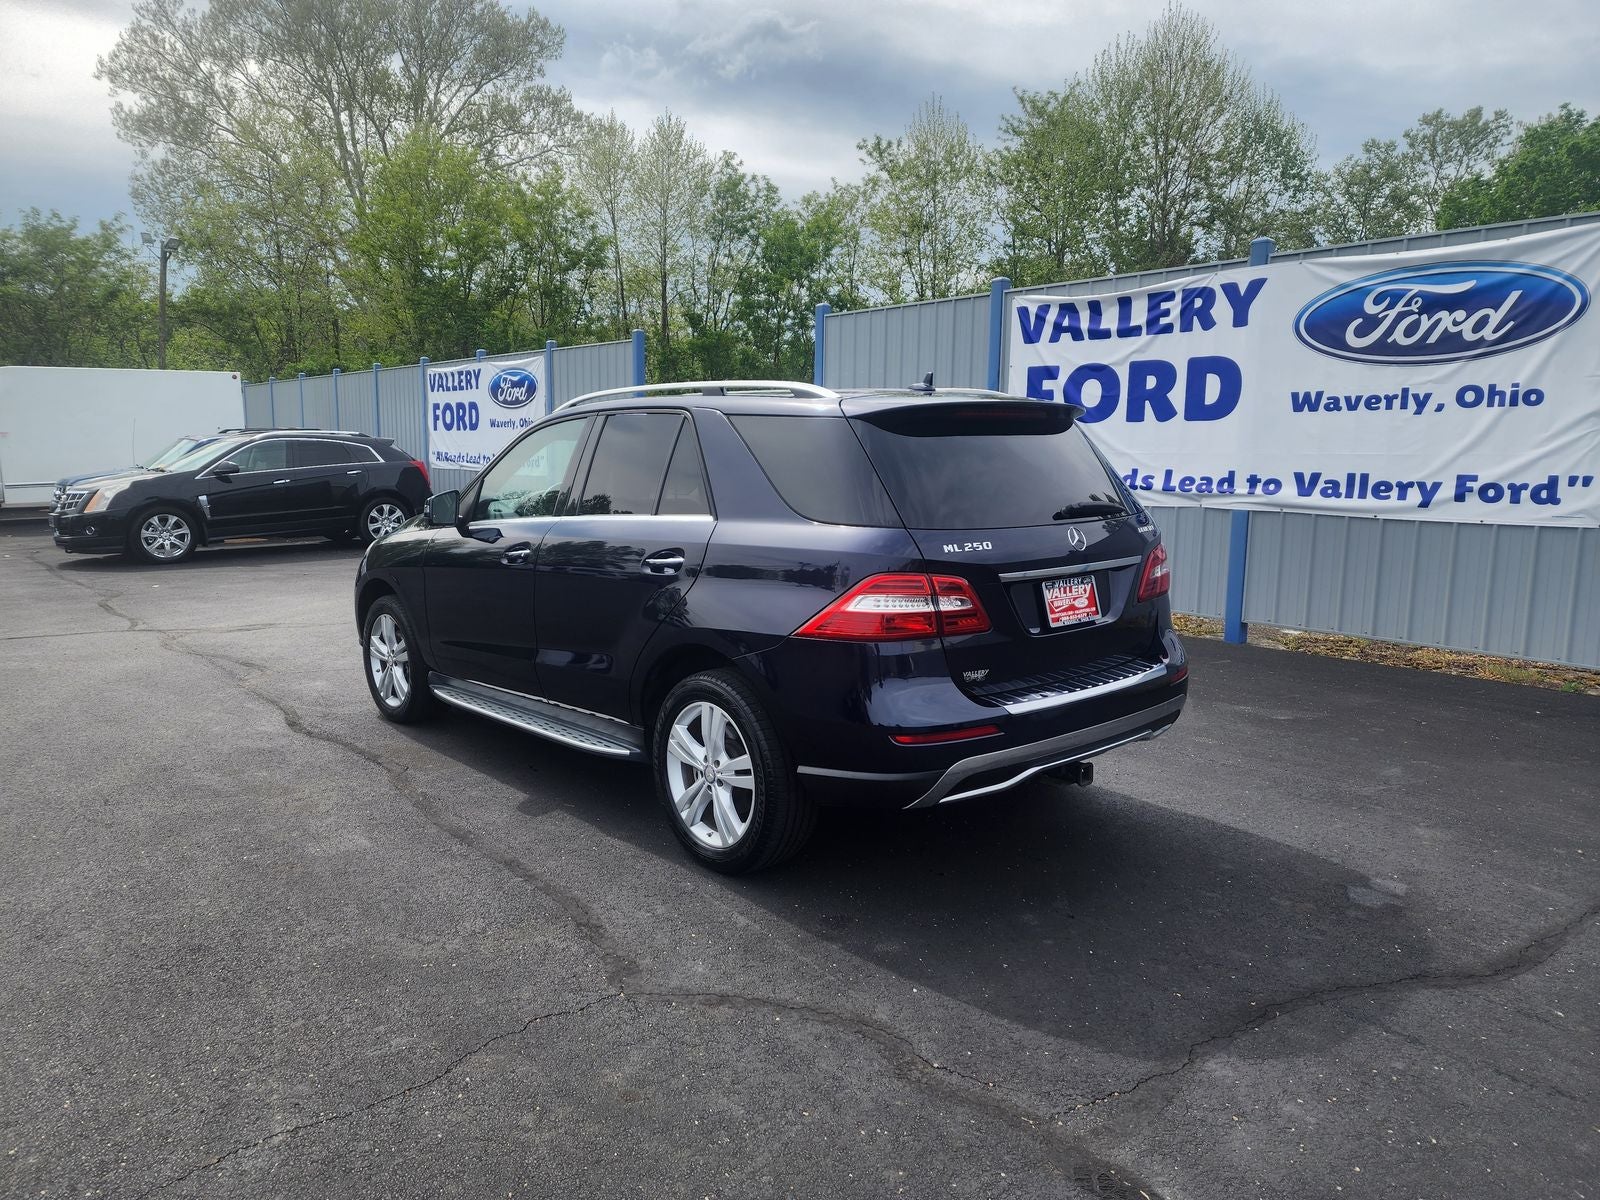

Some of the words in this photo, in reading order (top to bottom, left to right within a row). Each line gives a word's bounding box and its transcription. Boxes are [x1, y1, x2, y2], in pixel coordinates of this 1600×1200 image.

[1017, 278, 1267, 344] VALLERY
[1345, 279, 1523, 349] Ford
[429, 368, 481, 392] VALLERY
[498, 375, 528, 401] Ford
[1026, 355, 1243, 424] FORD
[1290, 388, 1445, 416] Waverly,
[1455, 381, 1546, 410] Ohio
[433, 402, 480, 431] FORD
[489, 418, 518, 431] Waverly,
[1161, 468, 1236, 495] Lead
[1246, 474, 1283, 496] to
[1293, 471, 1443, 509] Vallery
[1453, 474, 1594, 506] Ford"
[942, 543, 963, 553] ML
[963, 541, 993, 552] 250
[1046, 583, 1092, 600] VALLERY
[1055, 577, 1083, 588] VALLERY
